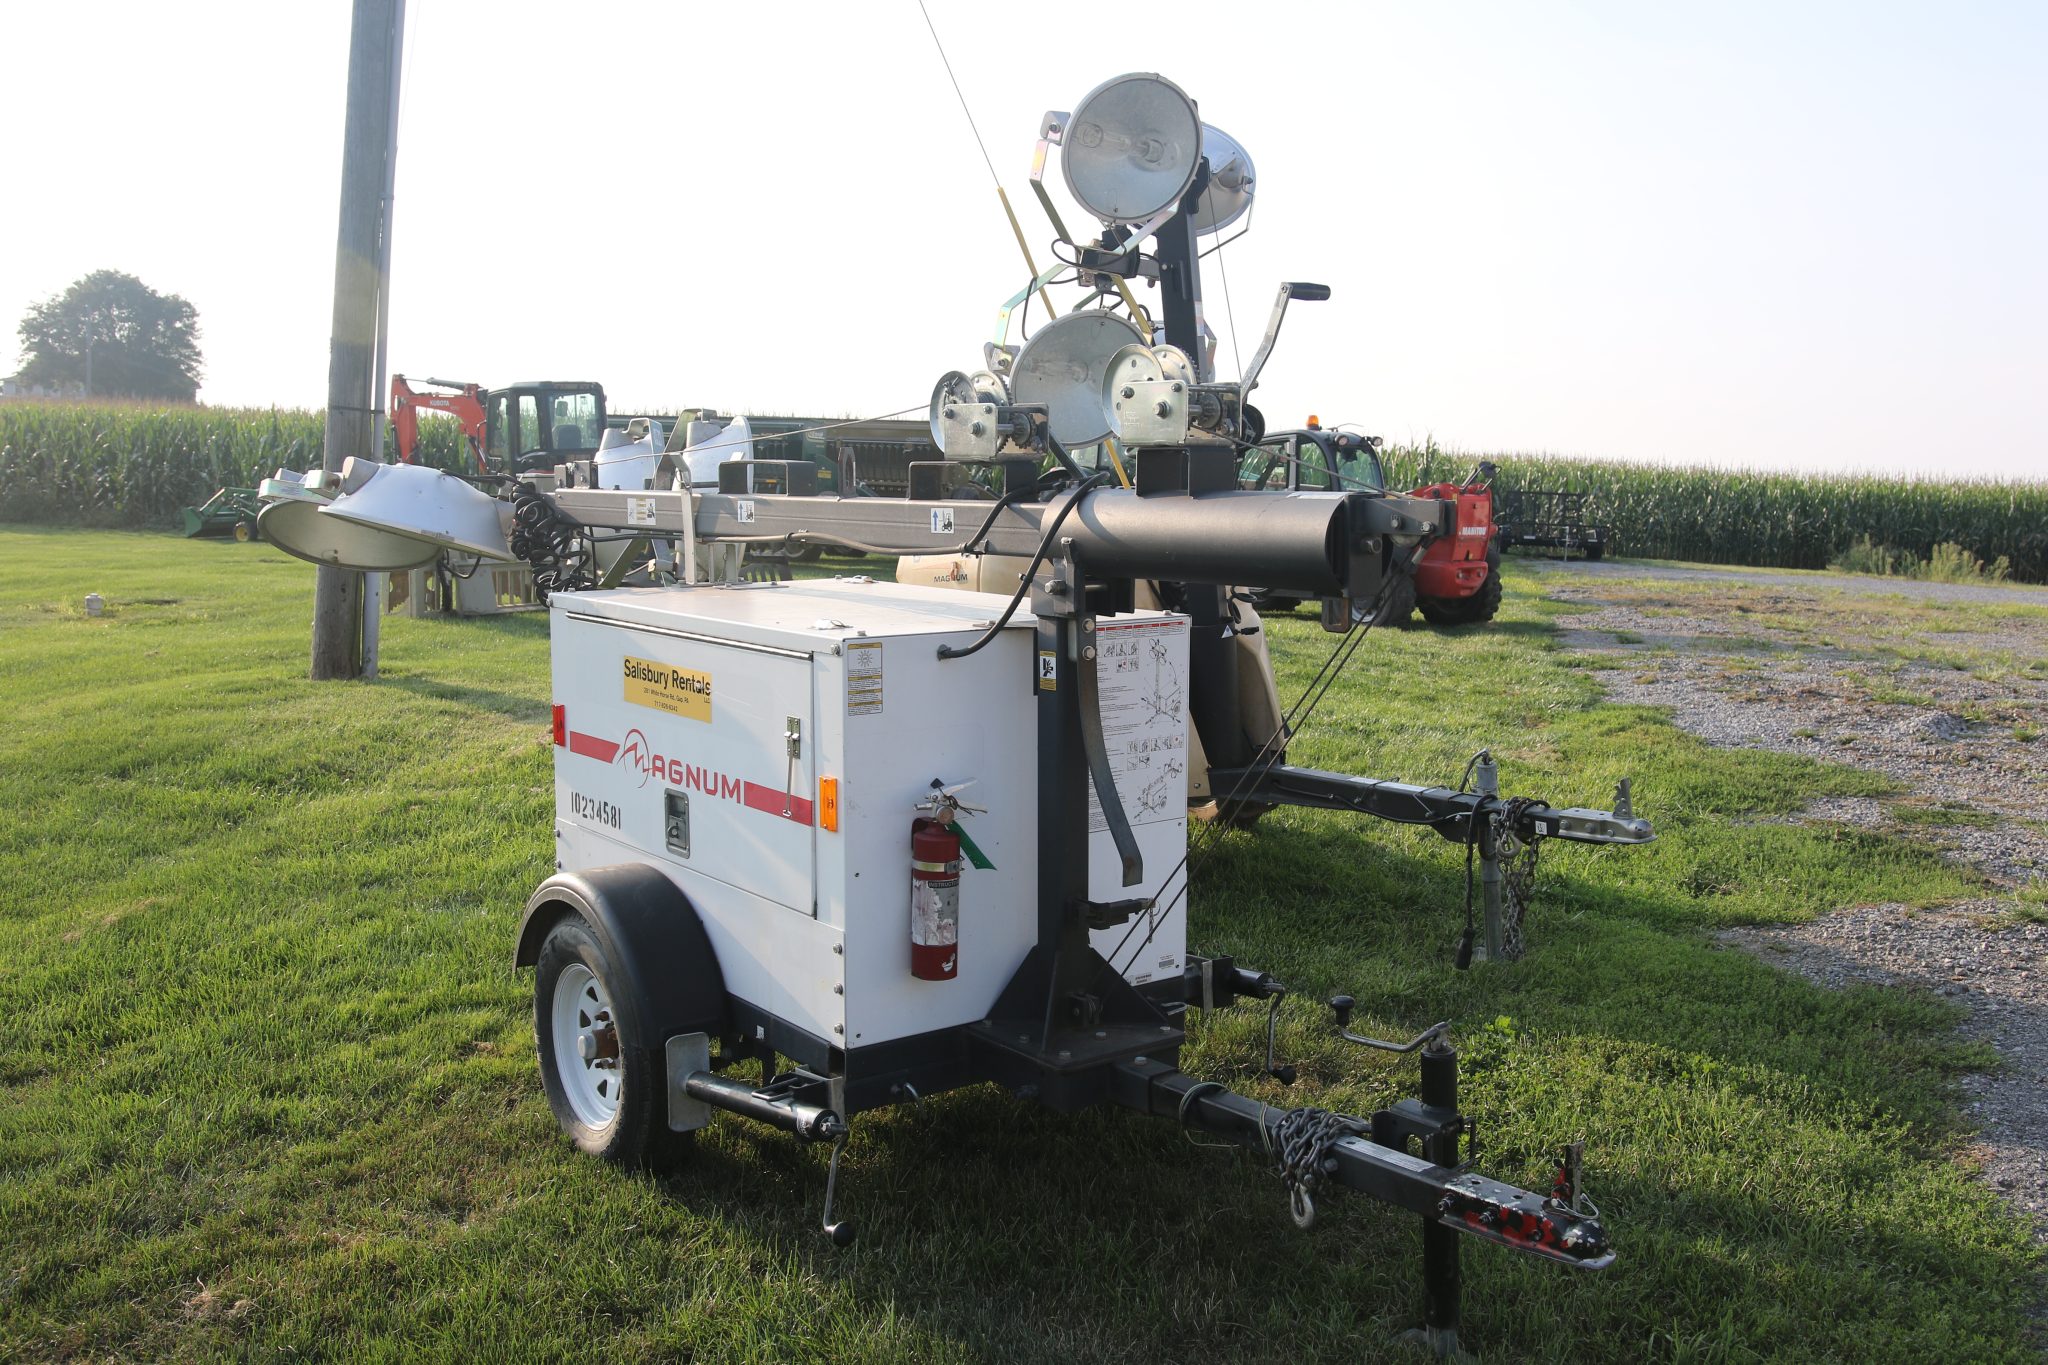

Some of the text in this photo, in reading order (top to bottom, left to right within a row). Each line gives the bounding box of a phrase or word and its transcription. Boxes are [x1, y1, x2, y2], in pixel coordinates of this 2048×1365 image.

[429, 399, 450, 407] KUBOTA
[1461, 526, 1487, 536] MANITOU
[624, 659, 711, 697] Salisbury Rentals
[617, 739, 742, 805] MAGNUM
[570, 791, 622, 830] 10234581
